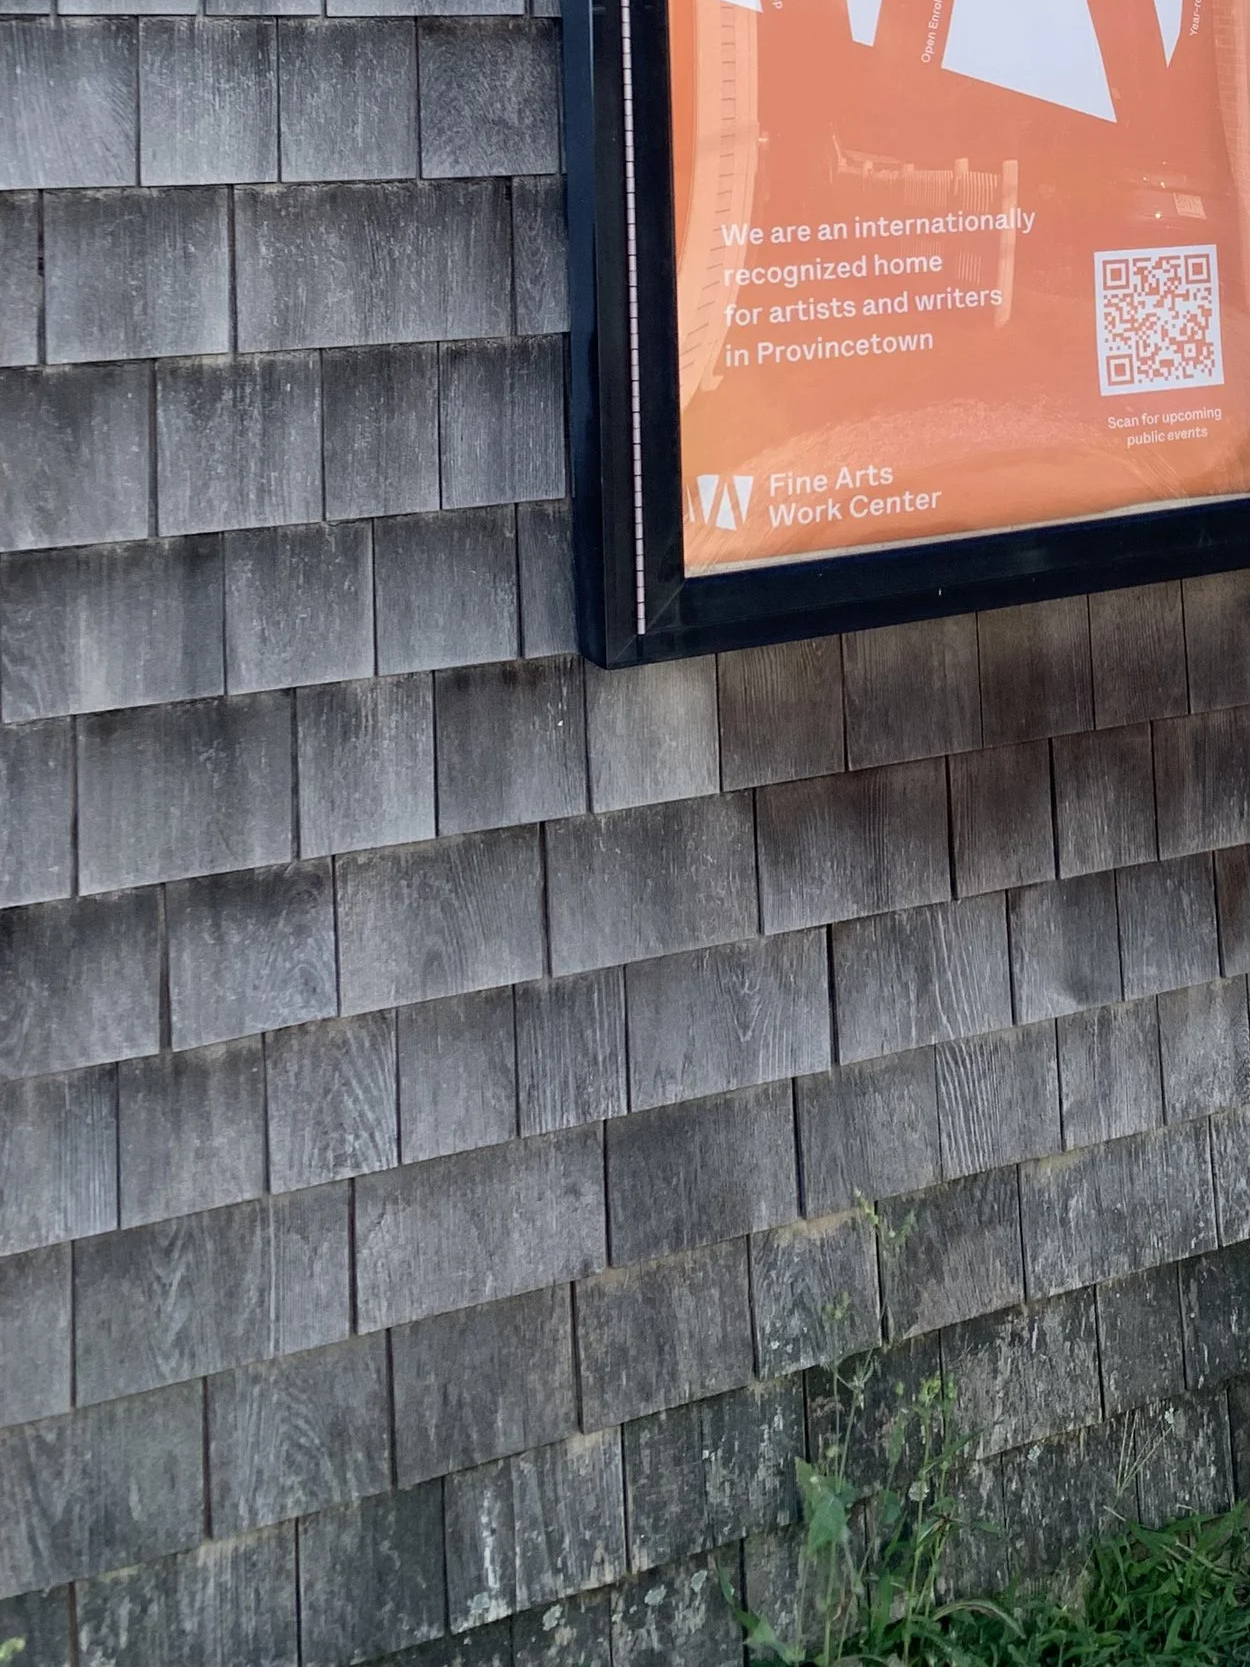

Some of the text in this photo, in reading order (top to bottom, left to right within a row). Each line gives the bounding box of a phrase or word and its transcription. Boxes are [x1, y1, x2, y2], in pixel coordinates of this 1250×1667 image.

[920, 31, 936, 63] Open
[721, 207, 1036, 247] We are an internationally
[724, 253, 943, 288] recognized home
[724, 286, 1003, 327] for artists and writers
[724, 332, 934, 367] in Provincetown
[1107, 407, 1222, 429] Scan for upcoming
[1127, 426, 1208, 448] public events
[769, 464, 893, 497] Fine Arts
[768, 490, 942, 528] Work Center
